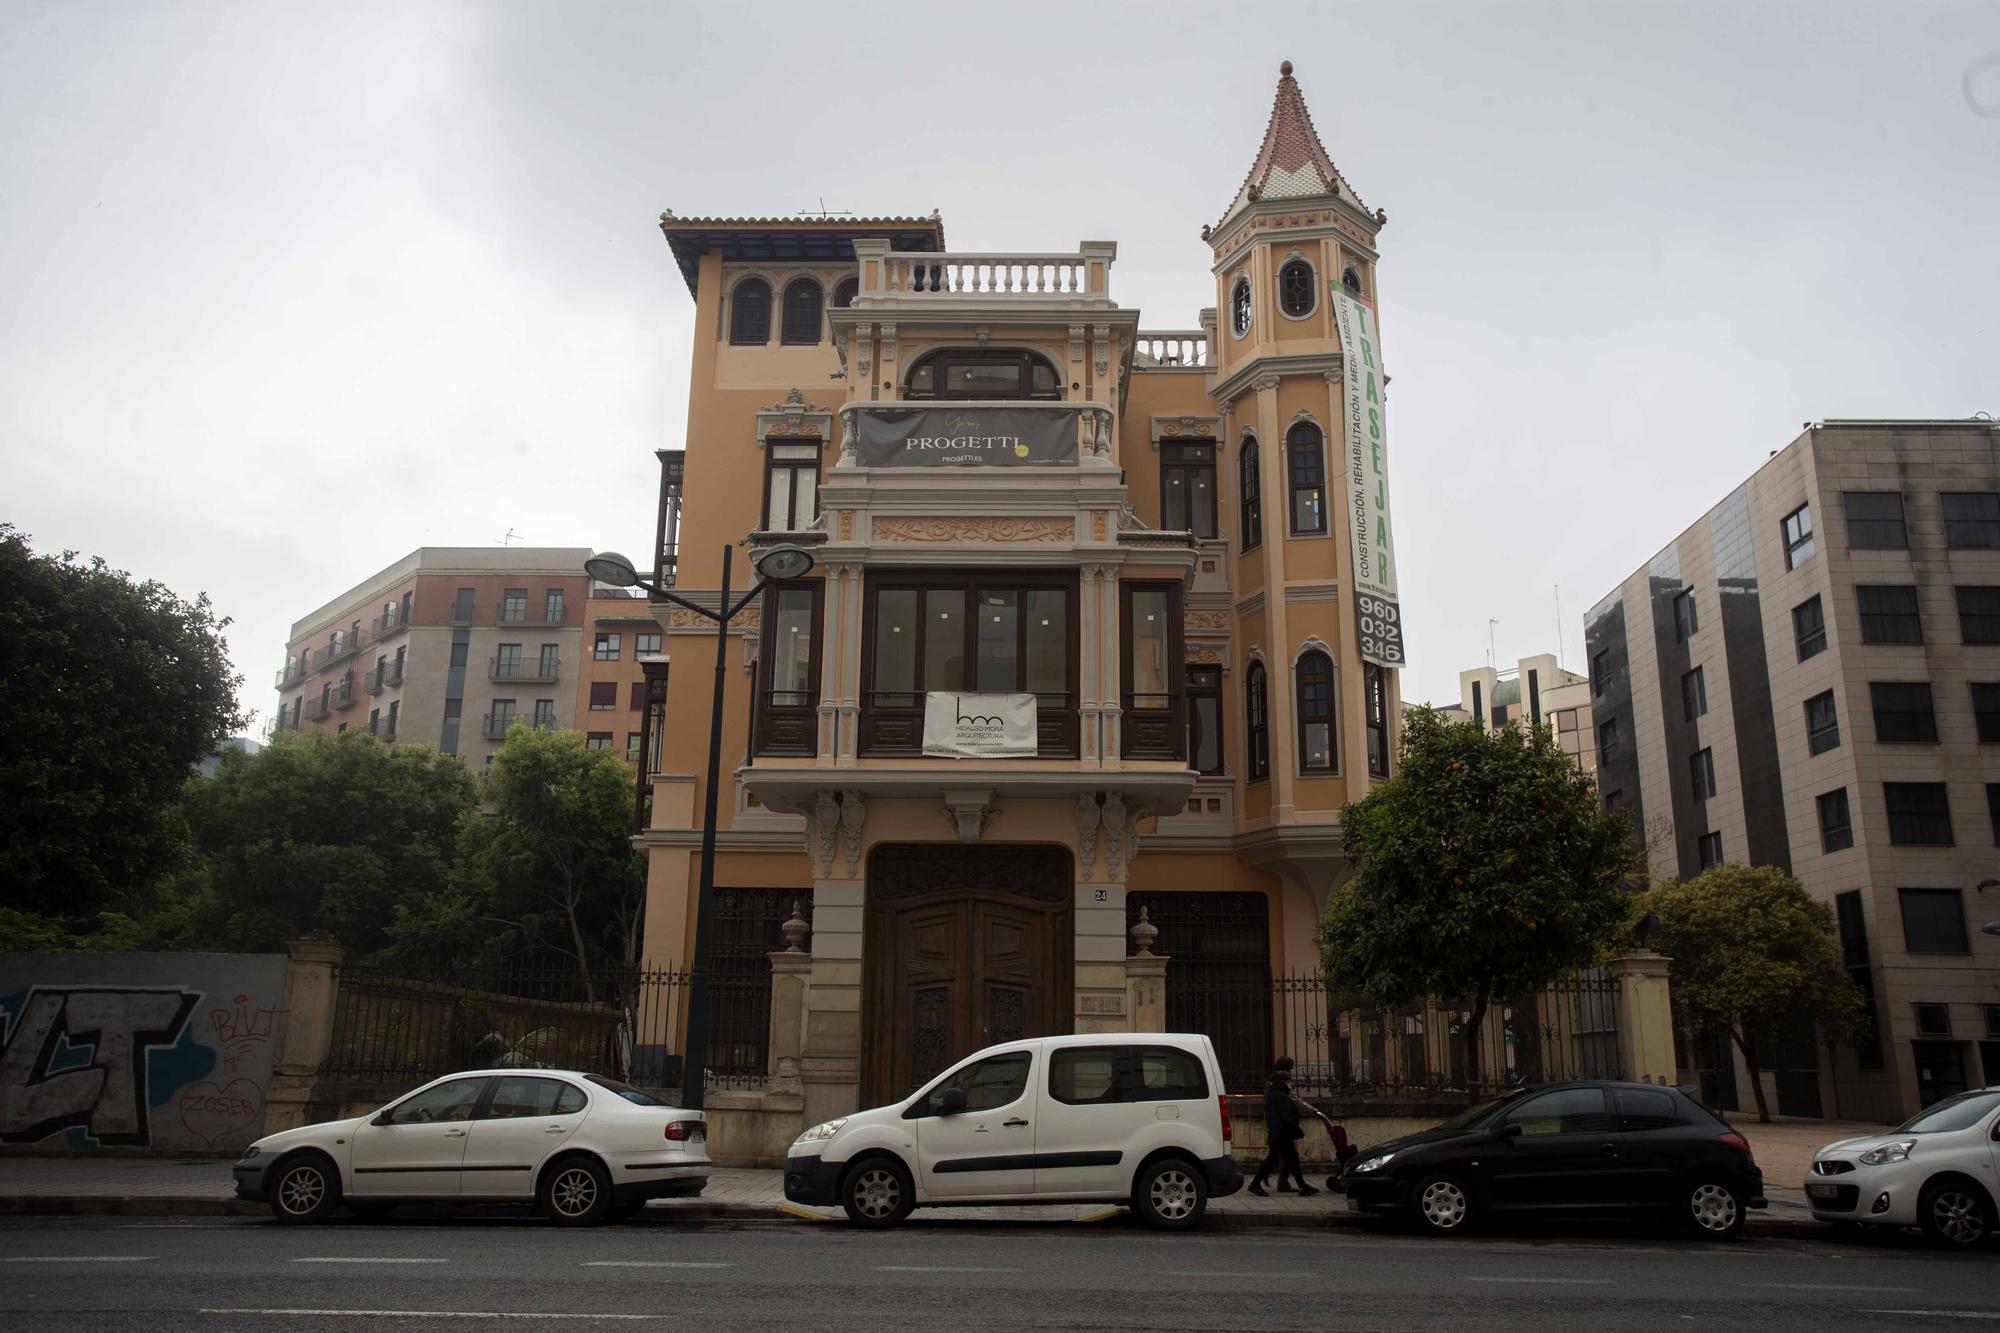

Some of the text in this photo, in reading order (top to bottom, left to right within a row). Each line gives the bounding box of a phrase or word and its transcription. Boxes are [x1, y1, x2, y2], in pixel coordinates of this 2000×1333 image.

[906, 436, 1020, 450] PROGETTI
[1339, 295, 1370, 578] CONSTRUCCIÓN, REHABILITACIÓN Y MEDIO AMBIENTE
[1354, 305, 1389, 586] TRASEJAR
[1359, 596, 1397, 623] 960
[1360, 616, 1399, 642] 032
[1361, 636, 1401, 661] 346
[1095, 891, 1106, 900] 24
[184, 1095, 256, 1117] ZOSER
